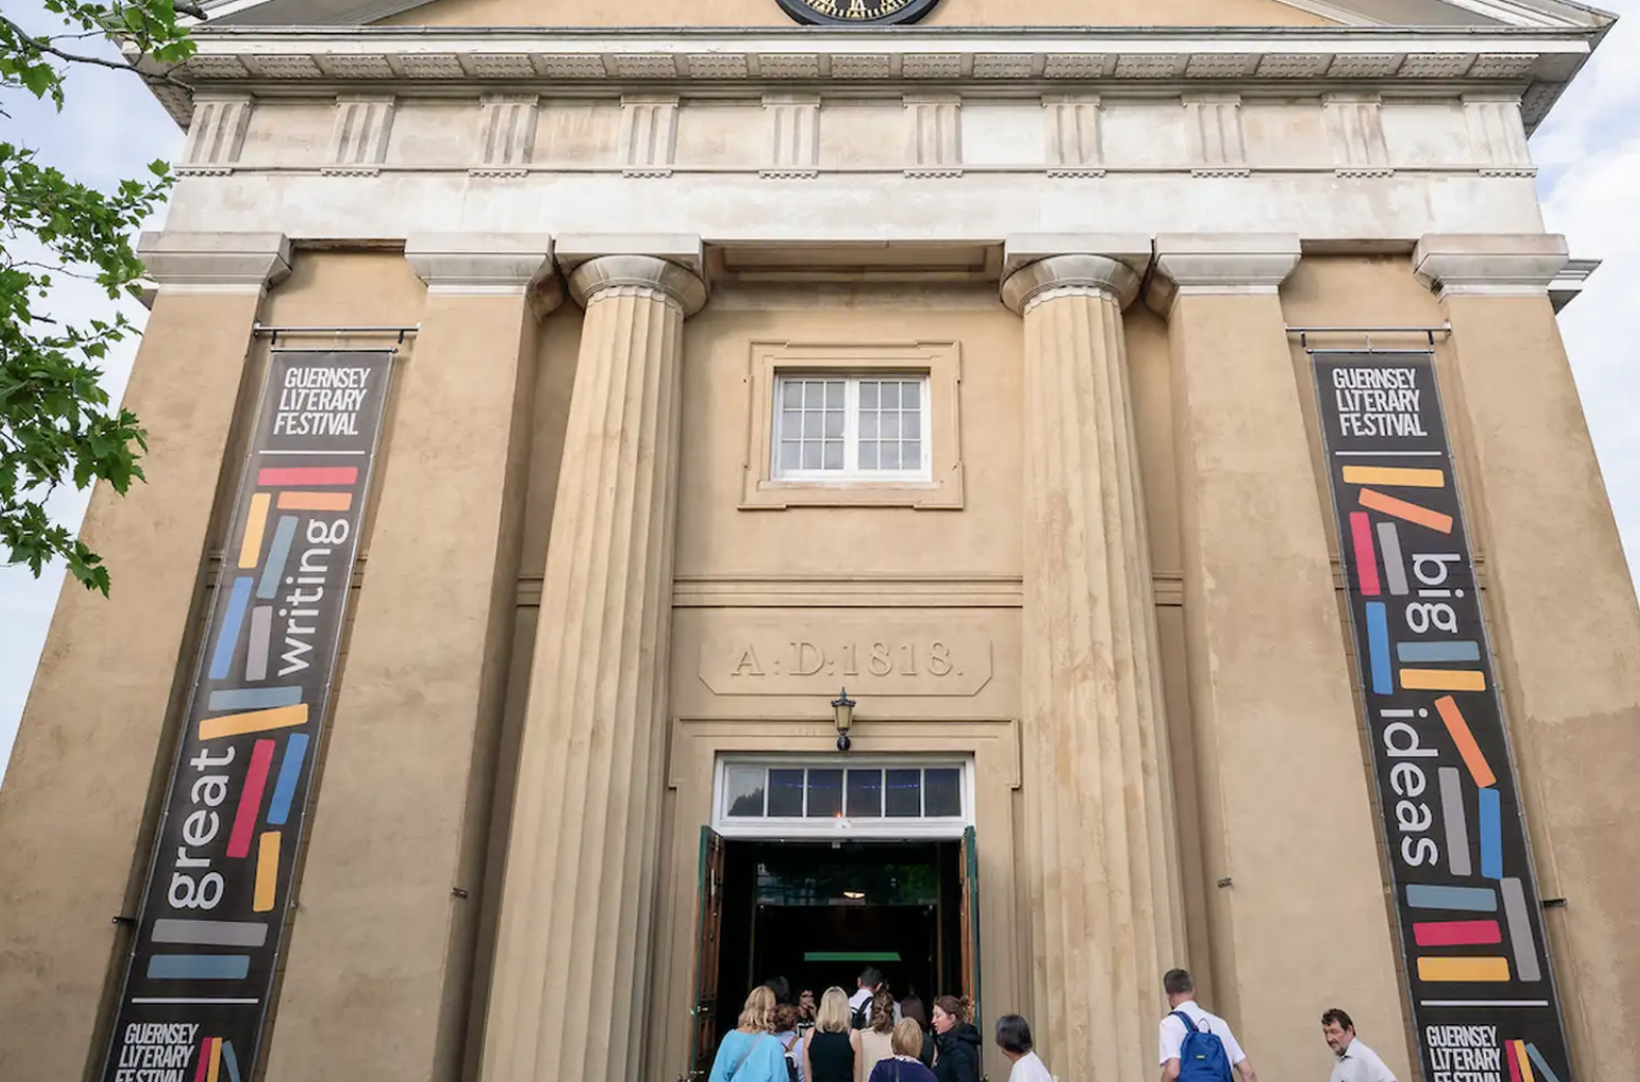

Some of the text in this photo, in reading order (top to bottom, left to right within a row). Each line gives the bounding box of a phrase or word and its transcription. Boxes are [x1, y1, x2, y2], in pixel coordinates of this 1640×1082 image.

[284, 367, 371, 389] GUERNSEY
[1332, 368, 1416, 389] GUERNSEY
[279, 388, 368, 412] LITERARY
[1336, 390, 1420, 412] LITERARY
[273, 412, 359, 436] FESTIVAL
[1340, 413, 1427, 437] FESTIVAL
[276, 518, 350, 678] writing
[1405, 553, 1465, 634] big
[1379, 707, 1439, 868] ideas
[167, 745, 237, 910] great
[124, 1023, 200, 1044] GUERNSEY
[1426, 1025, 1497, 1047] GUERNSEY
[118, 1045, 195, 1068] LITERARY
[1429, 1047, 1501, 1071] LITERARY
